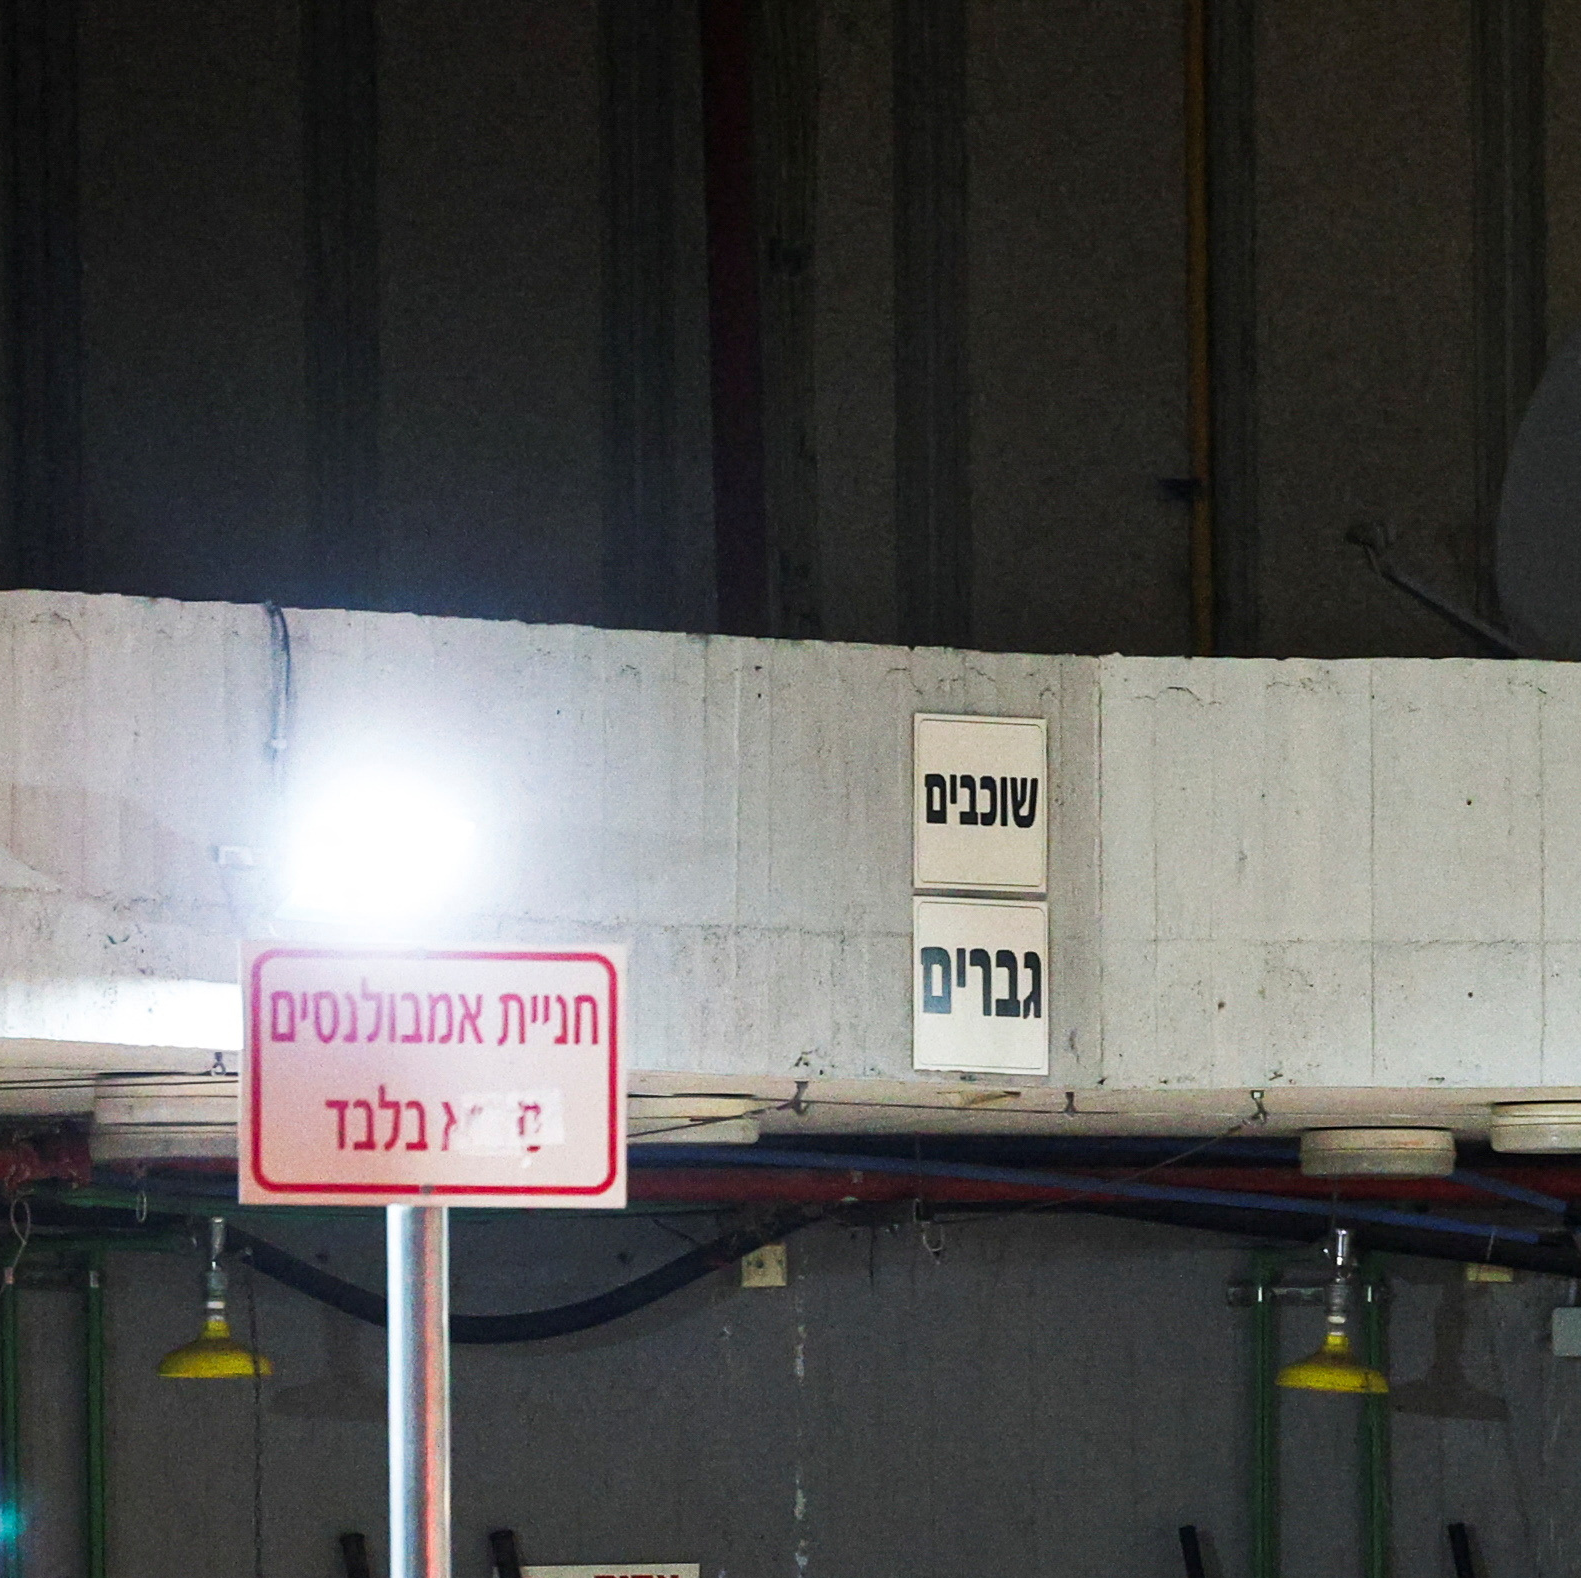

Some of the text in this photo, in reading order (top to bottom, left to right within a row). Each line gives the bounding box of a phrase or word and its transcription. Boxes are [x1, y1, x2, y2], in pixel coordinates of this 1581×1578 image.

[924, 773, 1039, 829] שוכבים
[270, 977, 600, 1046] חניית אמבולנסים
[920, 946, 1042, 1020] גברים
[324, 1084, 429, 1152] בלבד
